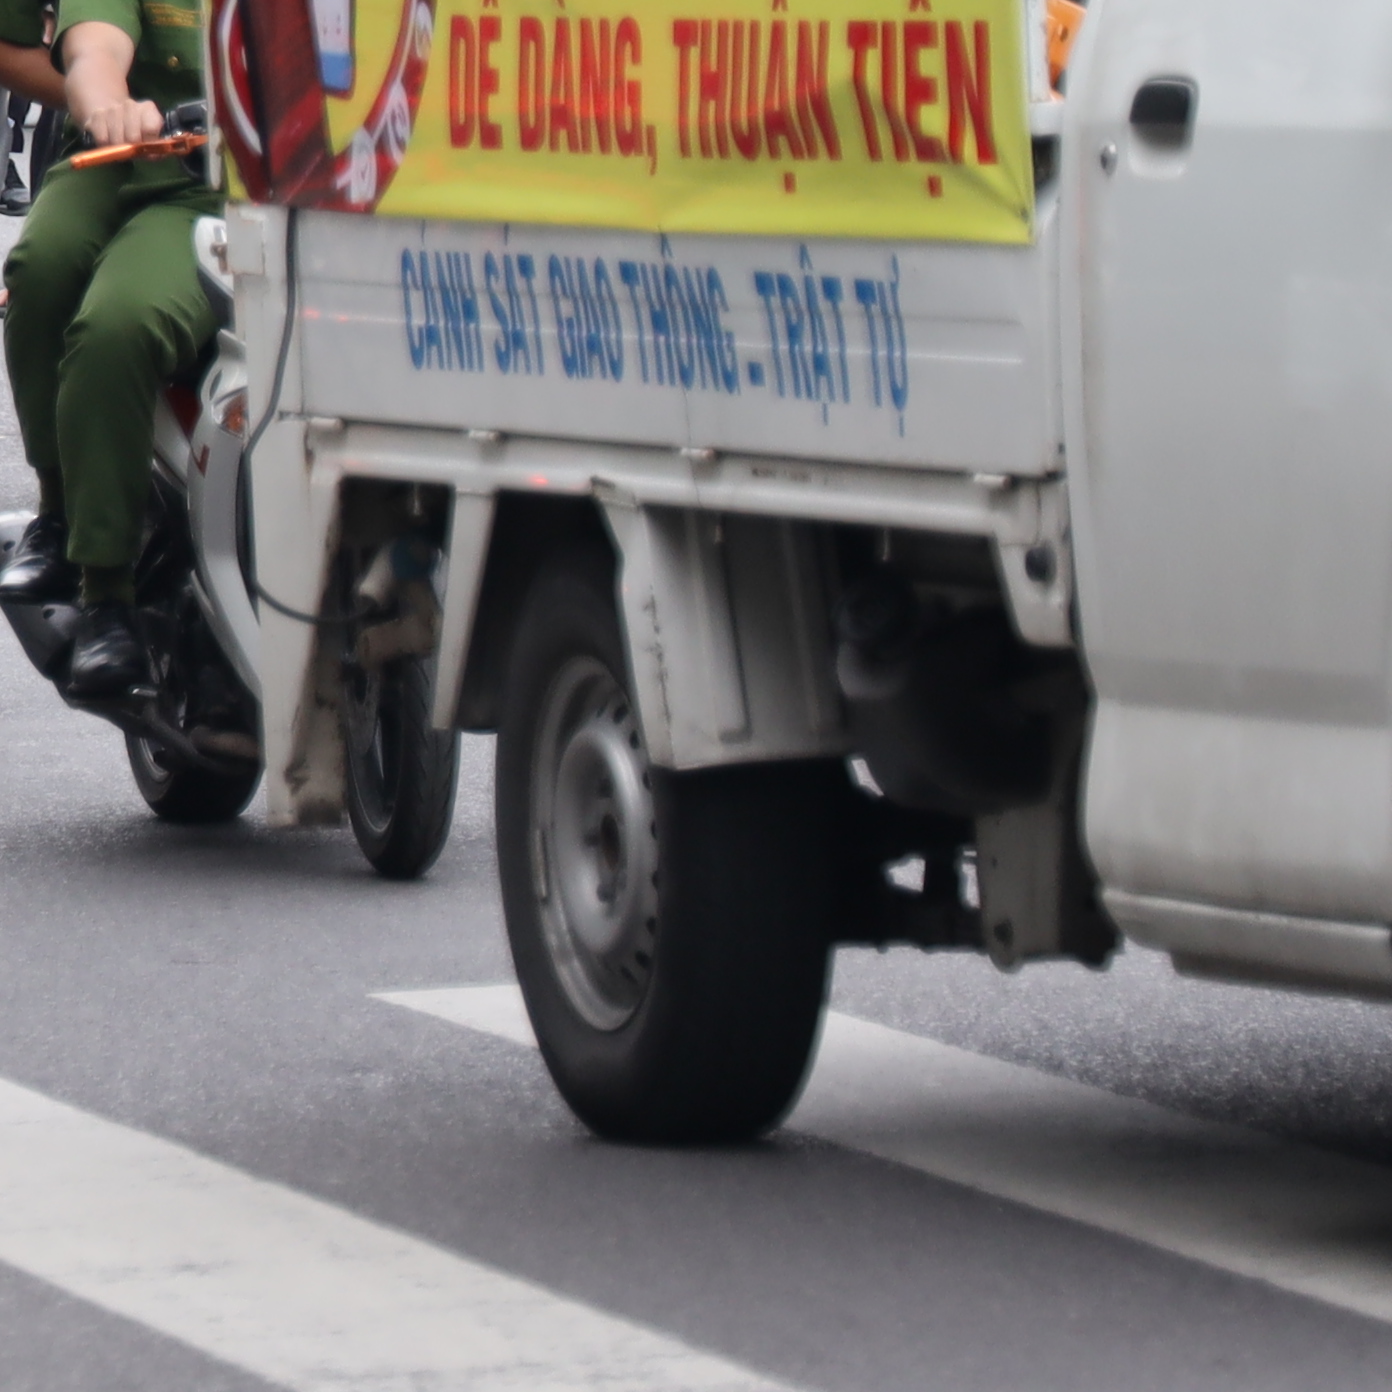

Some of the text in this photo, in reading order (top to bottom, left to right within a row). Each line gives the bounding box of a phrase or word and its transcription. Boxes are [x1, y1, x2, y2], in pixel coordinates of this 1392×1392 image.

[548, 252, 625, 384] GIAO
[619, 224, 741, 396] THÔNG
[753, 242, 850, 426] TRẬT
[853, 251, 909, 438] TỰ
